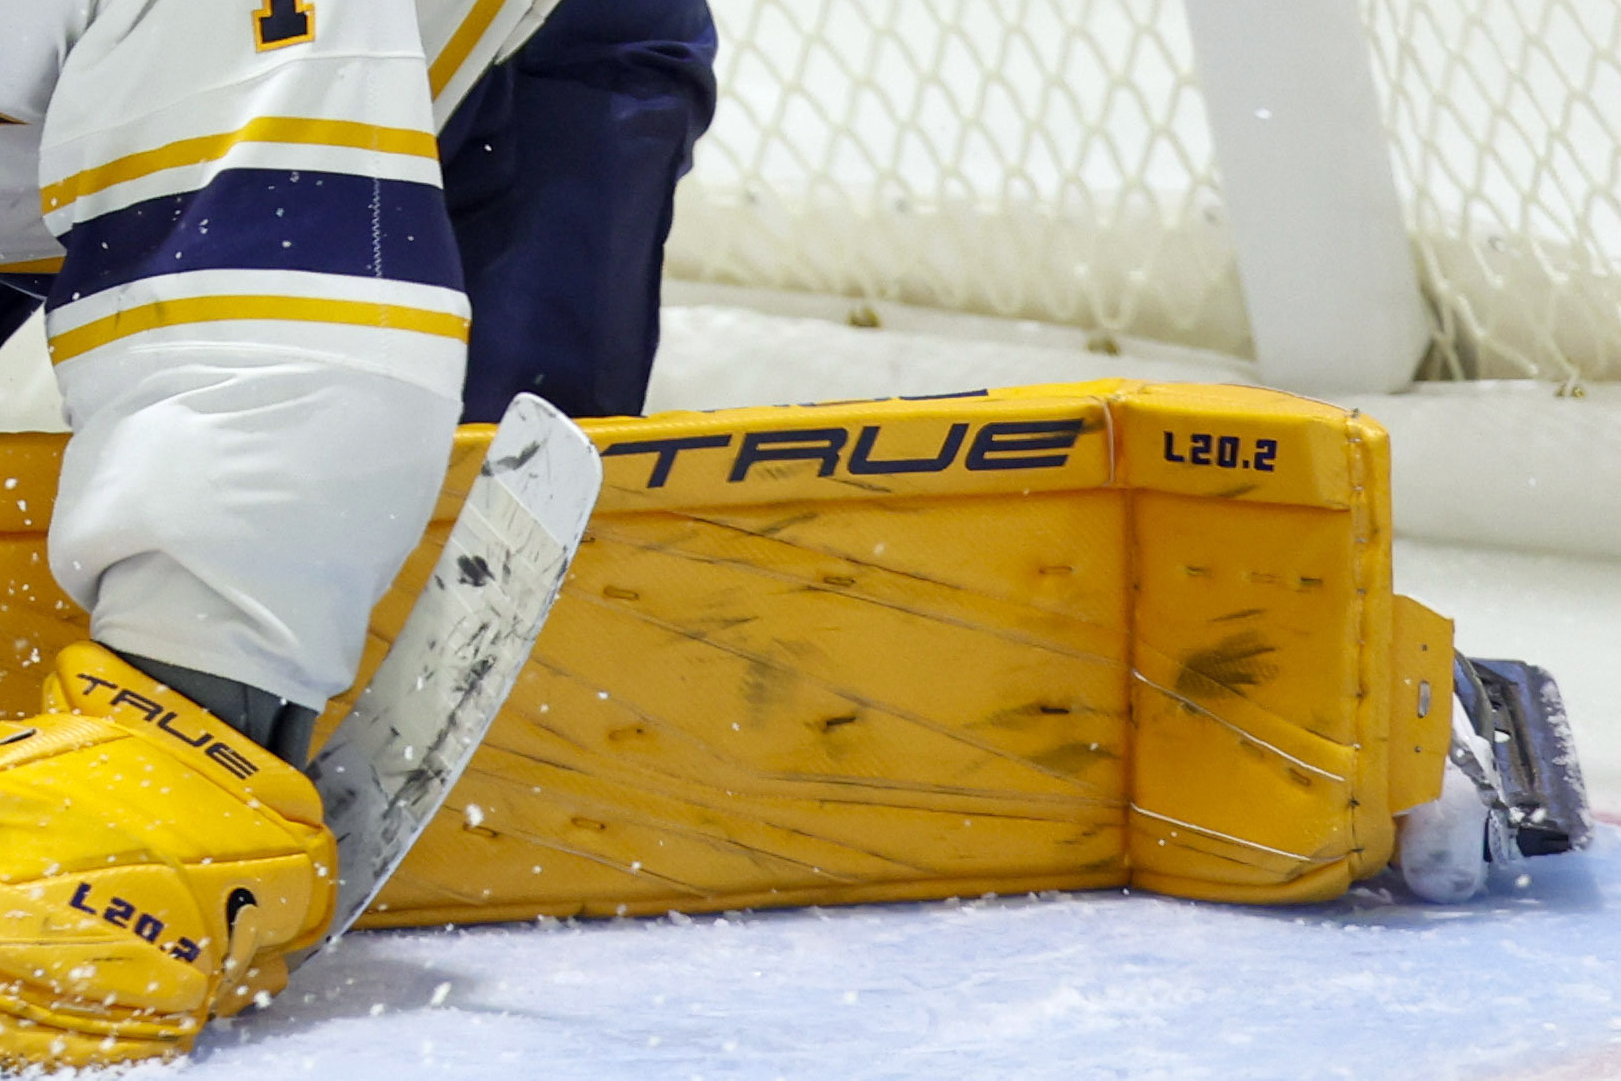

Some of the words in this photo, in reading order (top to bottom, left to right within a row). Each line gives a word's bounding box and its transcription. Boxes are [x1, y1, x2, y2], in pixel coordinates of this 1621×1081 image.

[600, 417, 1085, 489] TRUE
[1162, 429, 1278, 475] L20.2
[77, 672, 260, 782] TRUE
[68, 881, 201, 963] L20.2
